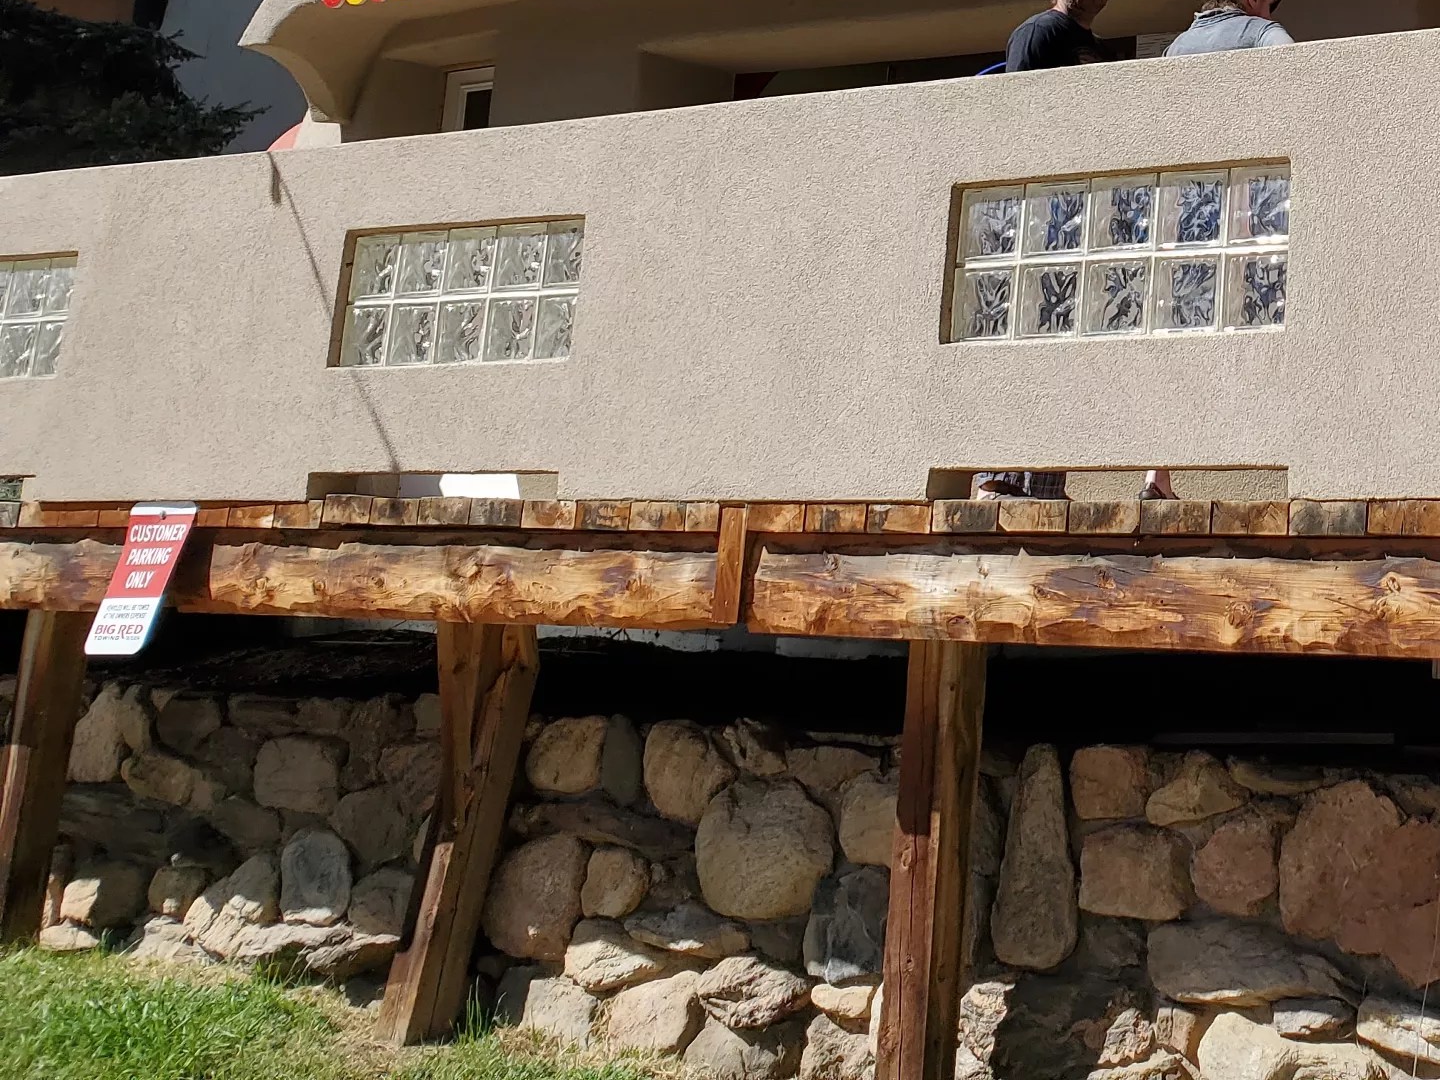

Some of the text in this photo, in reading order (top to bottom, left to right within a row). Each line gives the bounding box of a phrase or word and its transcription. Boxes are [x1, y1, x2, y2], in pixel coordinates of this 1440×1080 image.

[130, 524, 187, 543] CUSTOMER
[125, 547, 172, 566] PARKING
[125, 571, 155, 589] ONLY
[95, 624, 116, 635] BIG
[117, 624, 144, 640] RED
